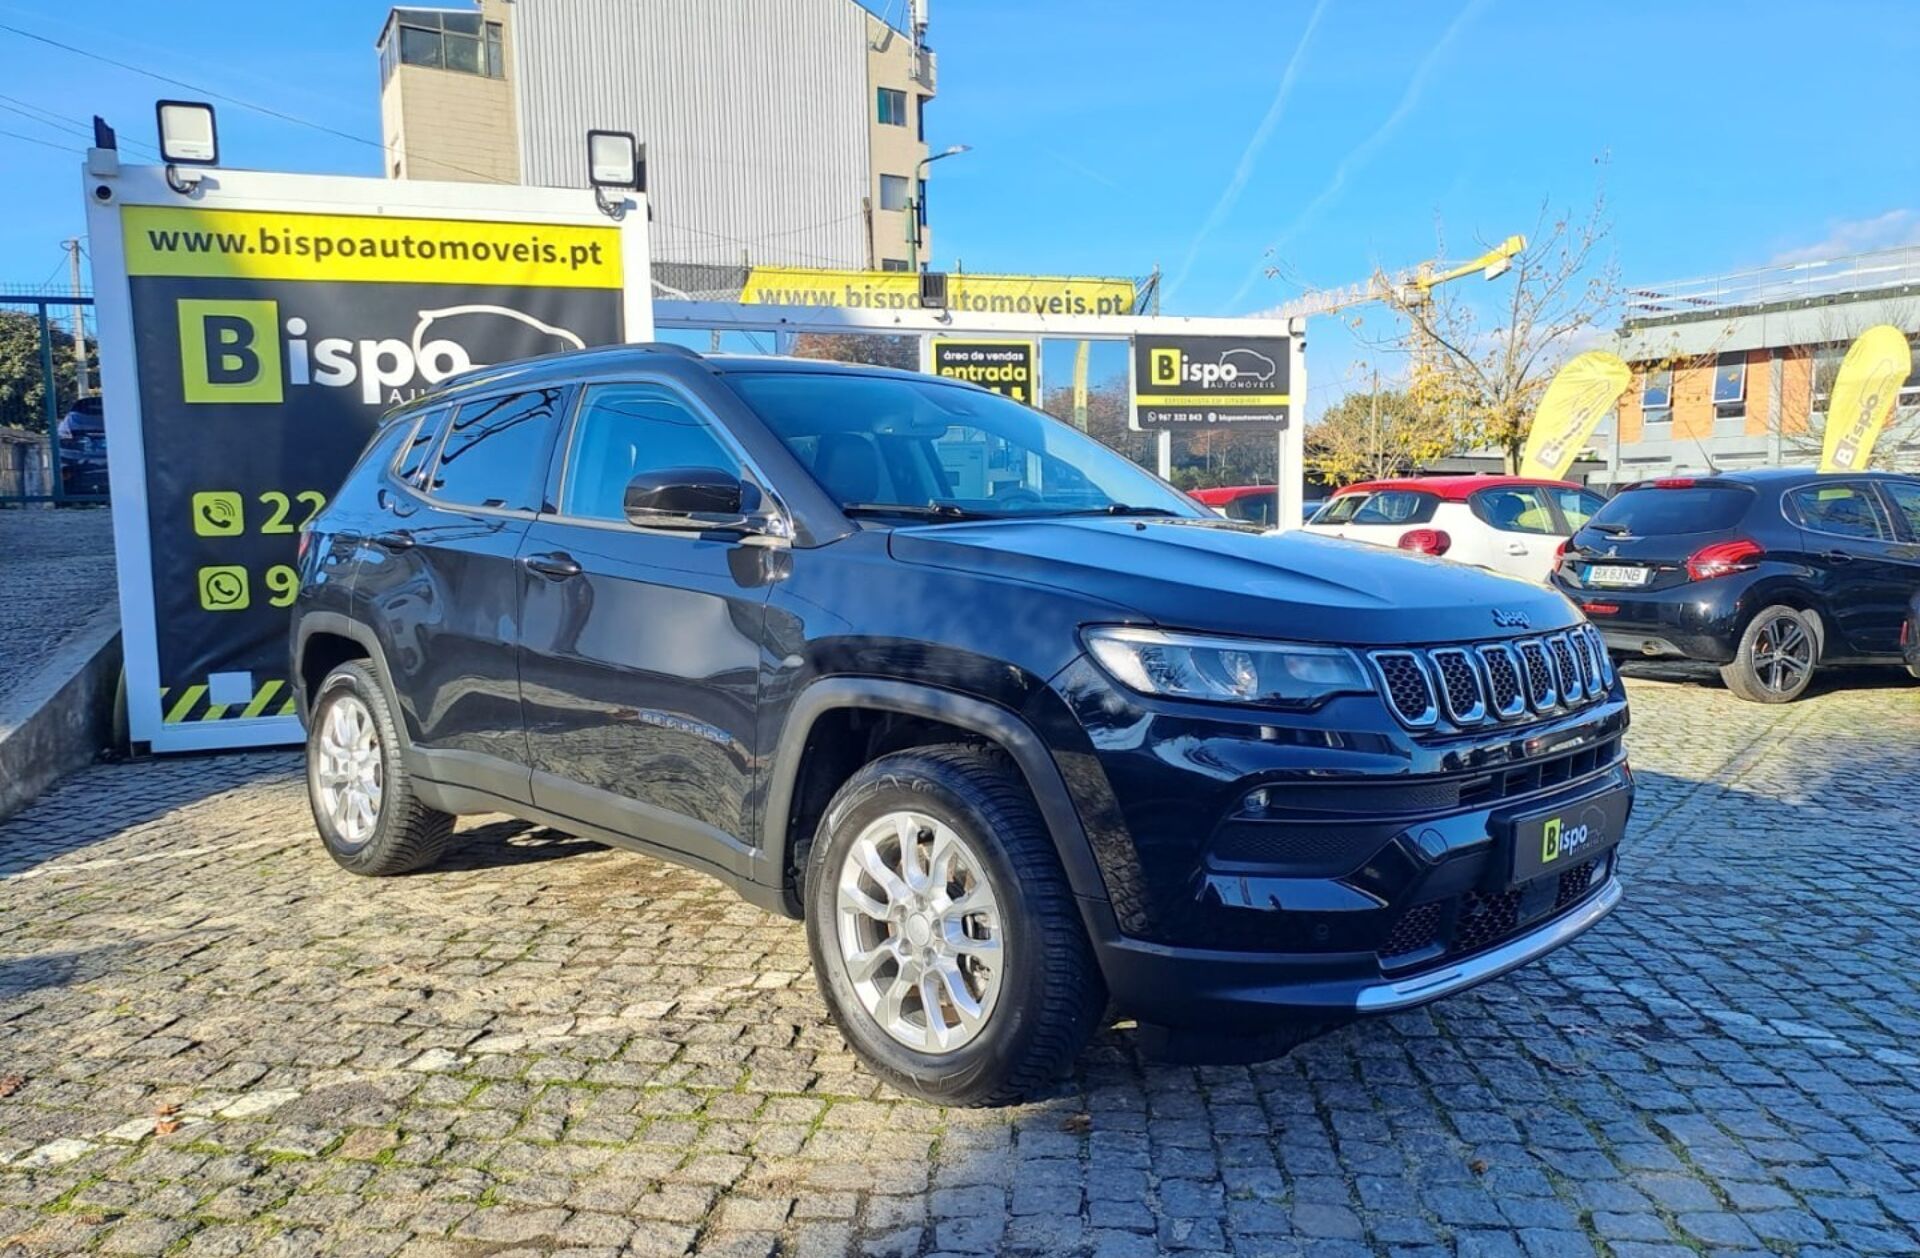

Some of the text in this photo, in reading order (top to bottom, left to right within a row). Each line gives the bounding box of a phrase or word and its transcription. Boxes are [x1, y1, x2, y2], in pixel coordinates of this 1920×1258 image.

[148, 228, 603, 270] www.bispoautomoveis.pt
[757, 284, 1124, 317] www.bispoutomoveis.pt
[203, 315, 471, 404] Bispo
[942, 362, 1027, 381] entrada
[971, 351, 985, 360] de
[986, 351, 1024, 360] vendas
[1158, 354, 1238, 388] Bispo
[1545, 822, 1588, 858] Bispo
